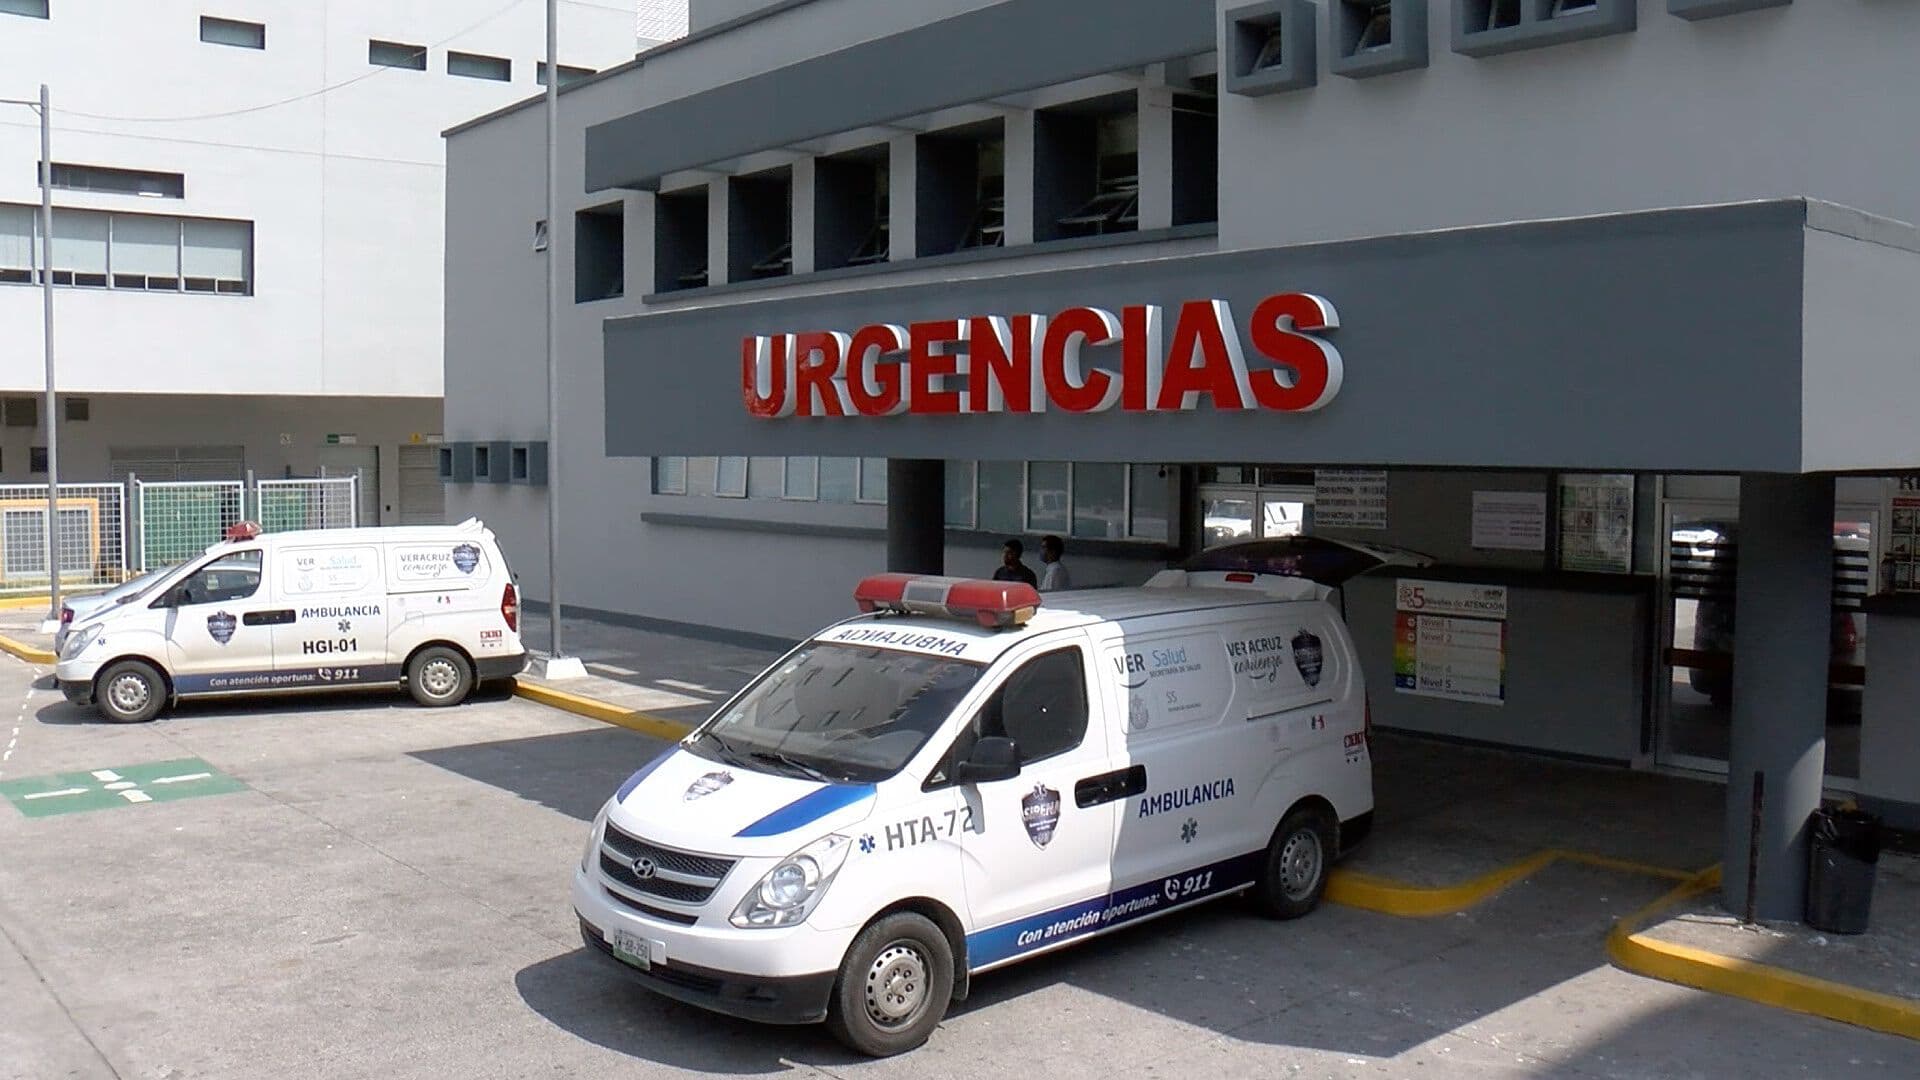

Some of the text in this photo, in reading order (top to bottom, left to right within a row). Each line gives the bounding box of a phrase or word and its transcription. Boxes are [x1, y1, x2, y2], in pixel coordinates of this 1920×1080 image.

[742, 293, 1343, 418] URGENCIAS
[297, 557, 315, 567] VER
[329, 554, 357, 566] Salud
[400, 553, 451, 563] VERACRUZ
[1413, 587, 1425, 609] 5
[301, 605, 381, 618] AMBULANCIA
[303, 638, 358, 655] HGI-01
[1152, 646, 1187, 668] Salud
[1226, 636, 1282, 657] VERACRUZ
[1114, 653, 1145, 674] VER
[209, 668, 360, 687] Con atención oportuna: 911
[1421, 677, 1443, 688] Nivel
[1139, 777, 1235, 818] AMBULANCIA
[885, 805, 975, 851] HTA-72
[1017, 871, 1213, 946] Con atención oportuna: 911
